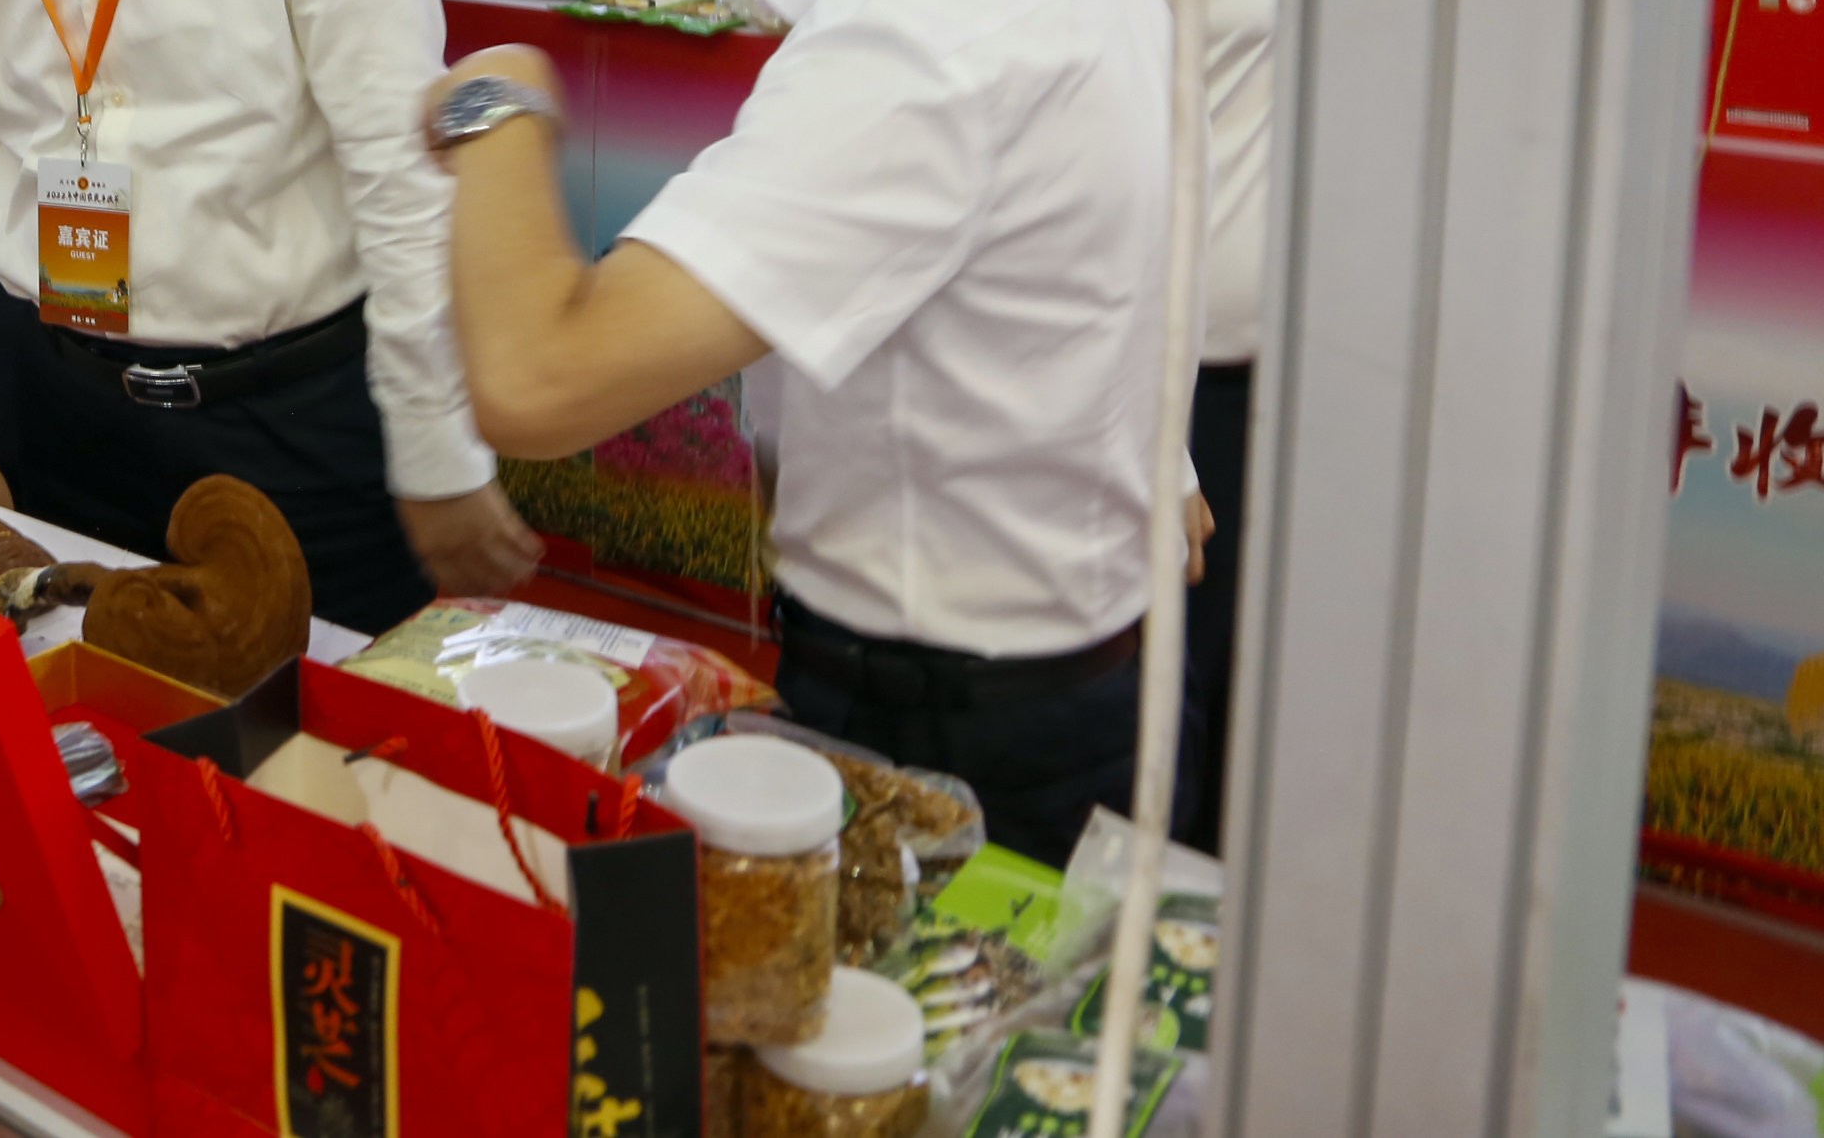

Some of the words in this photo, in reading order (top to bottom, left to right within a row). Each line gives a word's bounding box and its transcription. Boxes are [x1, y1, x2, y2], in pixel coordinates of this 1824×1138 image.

[58, 225, 110, 250] 嘉宾证
[70, 250, 96, 261] GUEST
